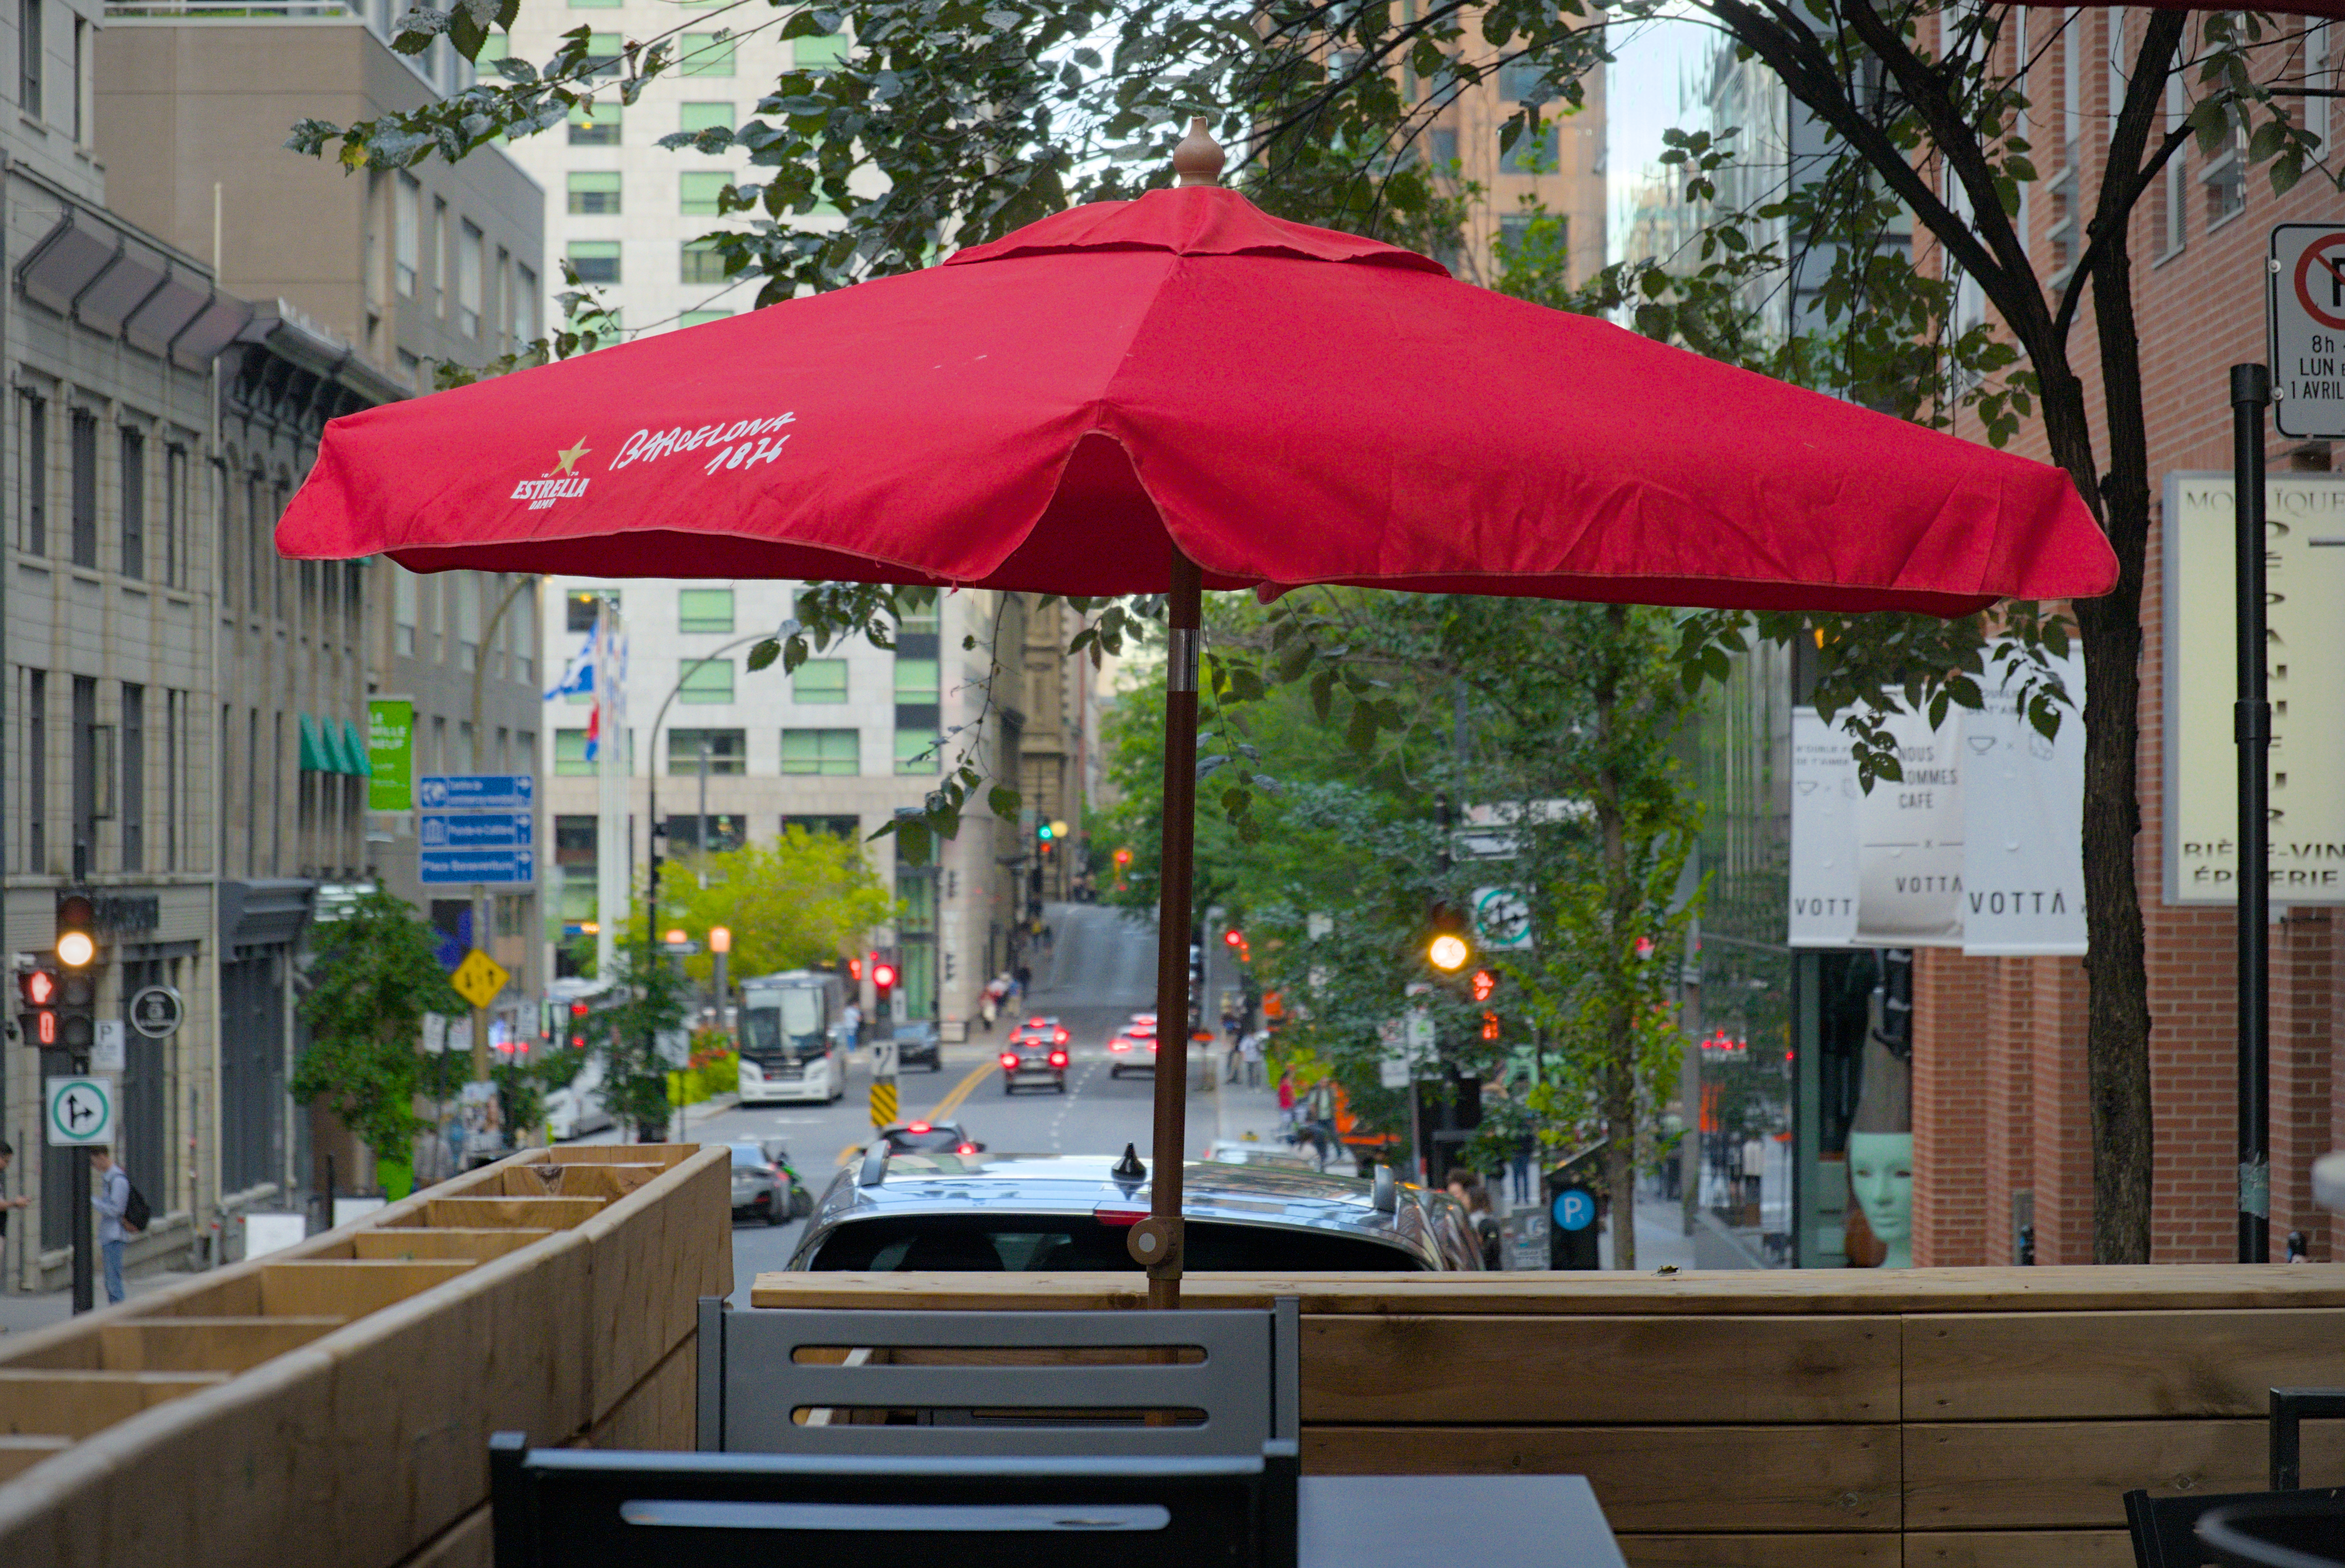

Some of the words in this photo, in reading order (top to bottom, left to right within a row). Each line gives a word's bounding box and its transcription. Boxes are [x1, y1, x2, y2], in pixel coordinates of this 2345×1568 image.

[2313, 335, 2334, 353] 8h
[2300, 358, 2334, 376] LUN
[2303, 381, 2344, 399] AVRIL
[608, 412, 796, 471] BARCELONA
[705, 435, 790, 475] 1876
[510, 478, 591, 500] ESTRELLA
[2187, 488, 2345, 518] MOÏQUE
[2194, 865, 2339, 886] ÉPERIE
[1795, 898, 1852, 916] VOTT
